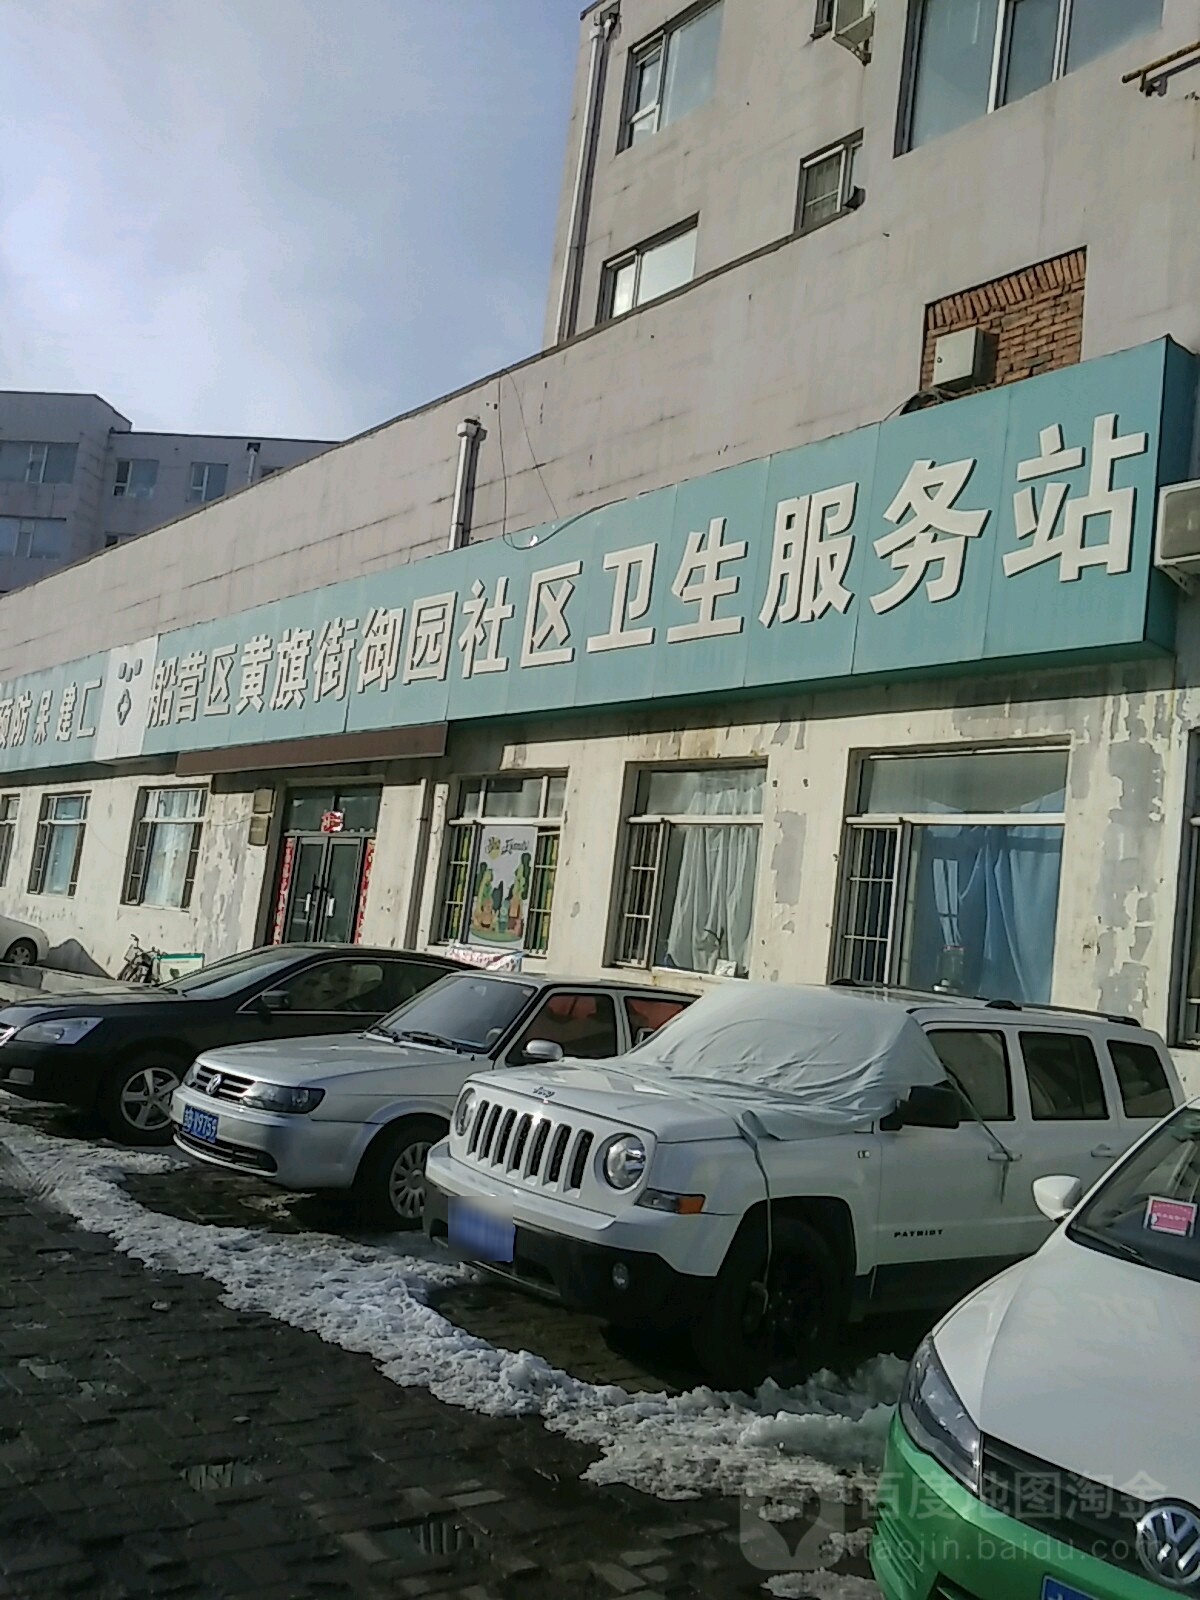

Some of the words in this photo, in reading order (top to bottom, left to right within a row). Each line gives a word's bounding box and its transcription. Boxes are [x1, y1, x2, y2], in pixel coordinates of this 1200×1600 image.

[146, 413, 1149, 728] 船营区黄旗街御园社区卫生服务站
[893, 1229, 943, 1238] PATRIOT
